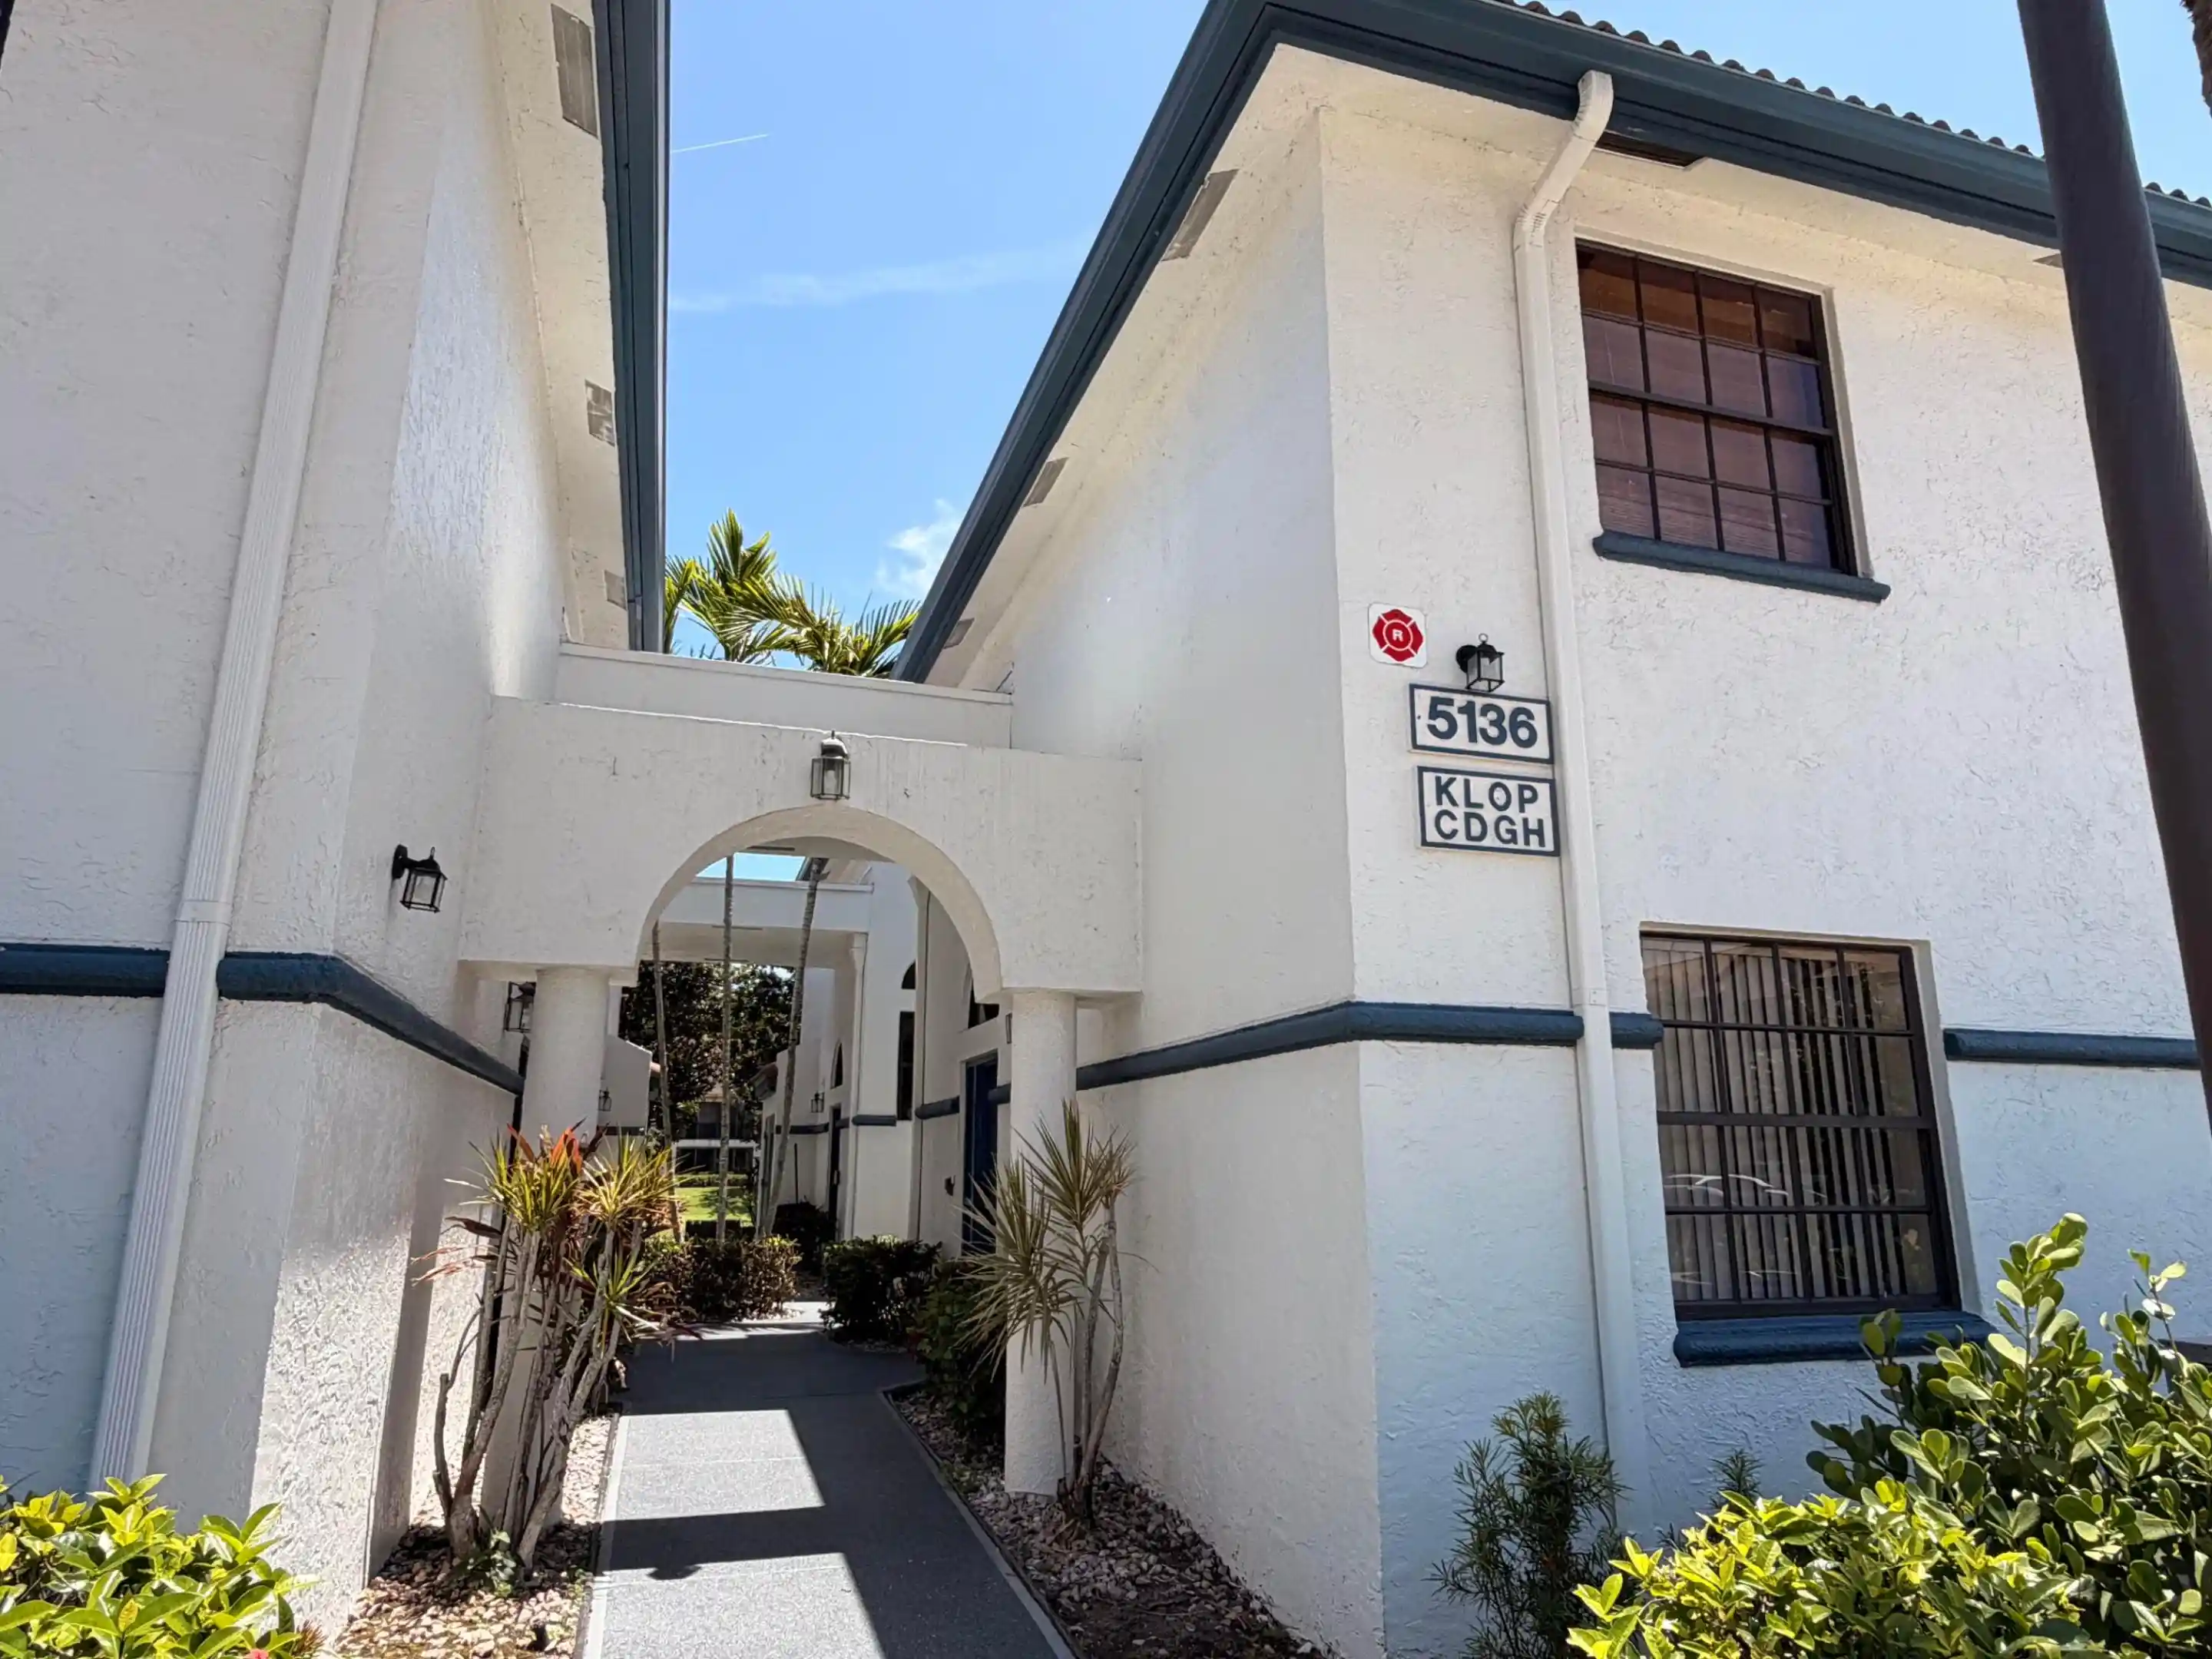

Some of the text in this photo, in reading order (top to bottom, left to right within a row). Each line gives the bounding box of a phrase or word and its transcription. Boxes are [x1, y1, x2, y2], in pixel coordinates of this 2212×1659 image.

[1427, 696, 1538, 749] 5136
[1434, 775, 1538, 813] KLOP
[1434, 809, 1546, 848] CDGH
